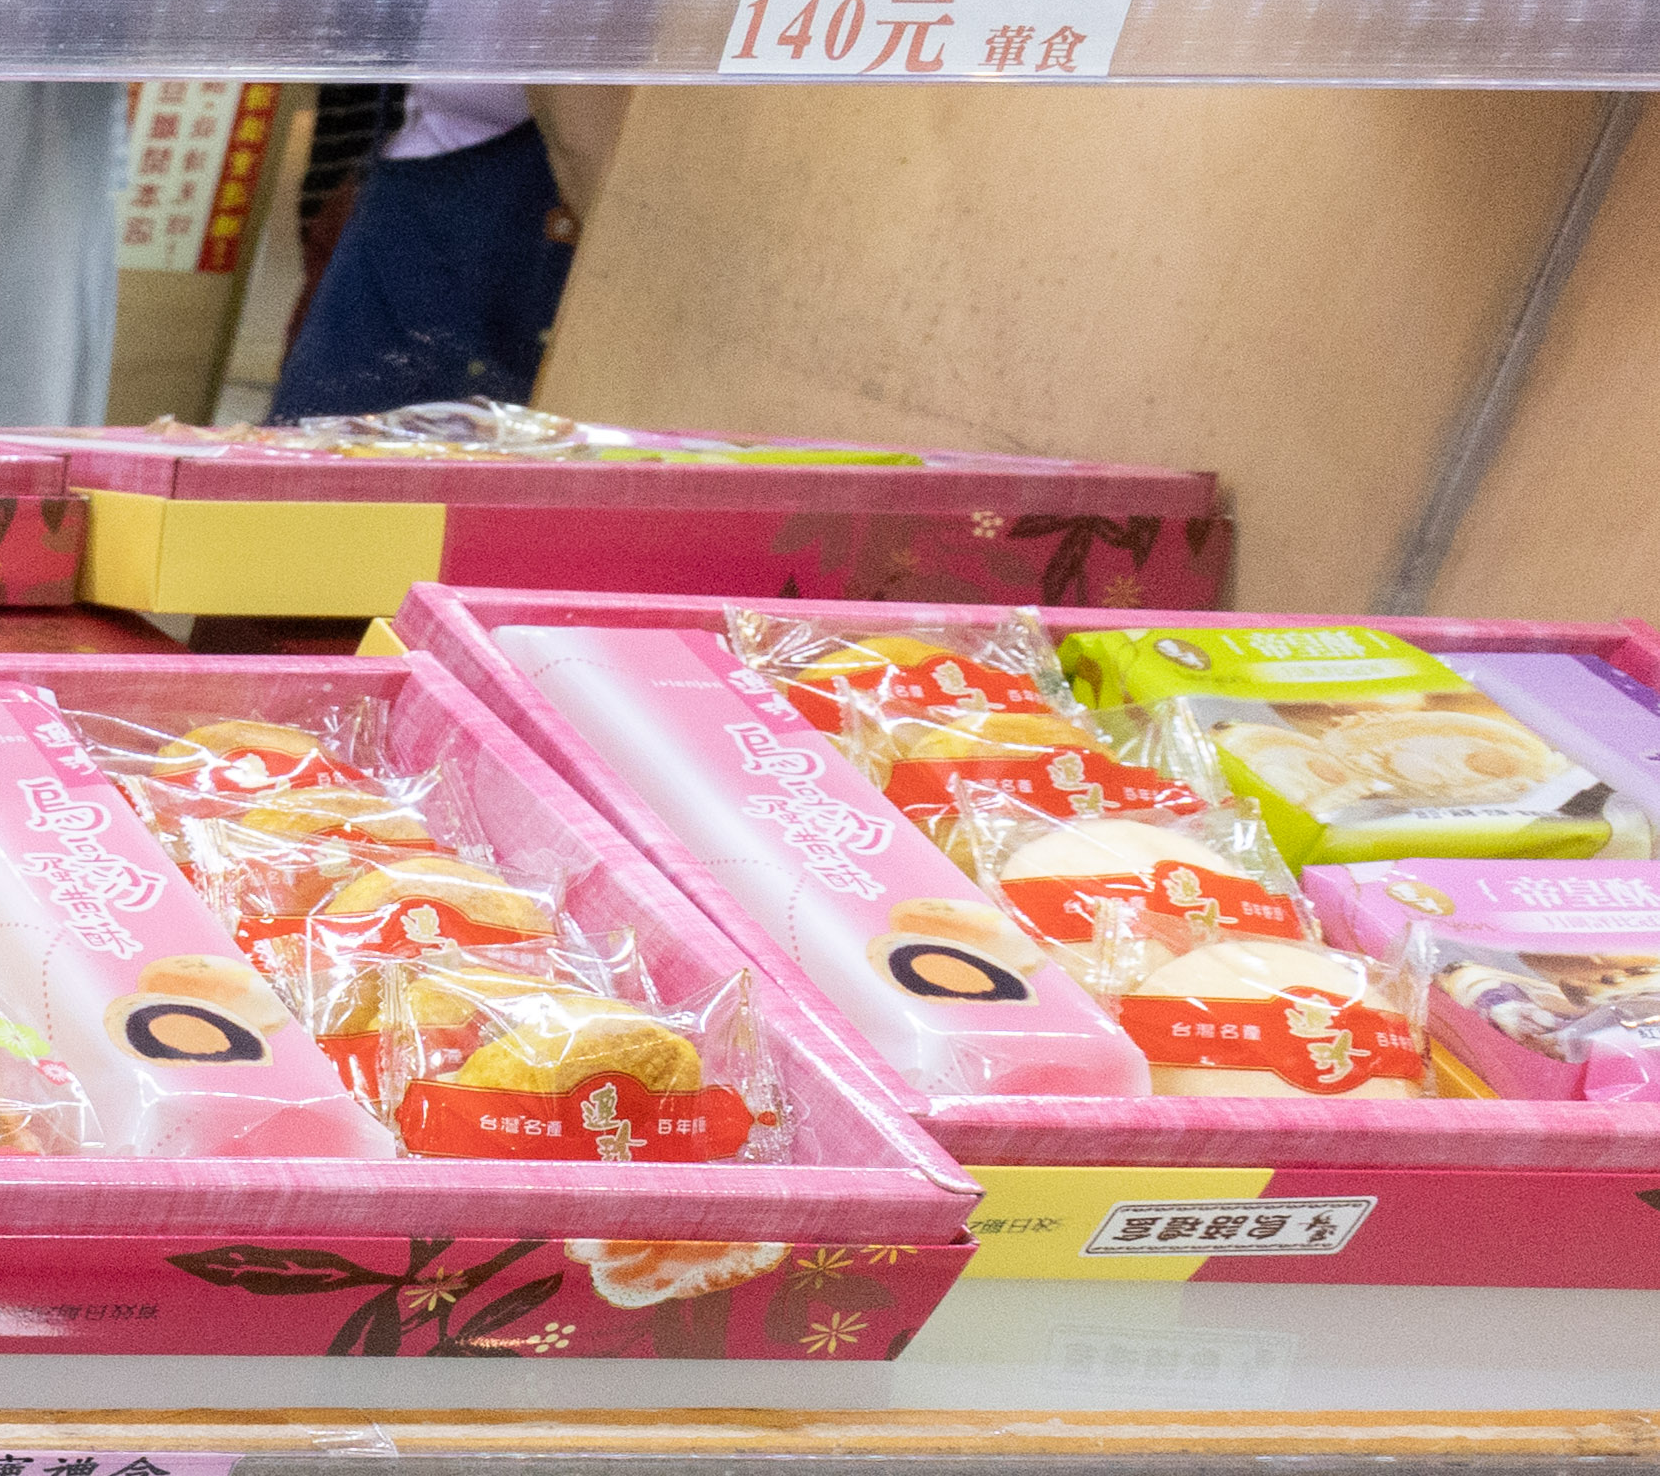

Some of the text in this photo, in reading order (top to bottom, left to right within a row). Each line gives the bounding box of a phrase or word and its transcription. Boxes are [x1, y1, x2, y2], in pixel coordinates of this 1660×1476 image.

[977, 25, 1088, 73] 葷食
[1170, 1020, 1262, 1042] 台灣名產
[478, 1114, 564, 1138] 台灣名產
